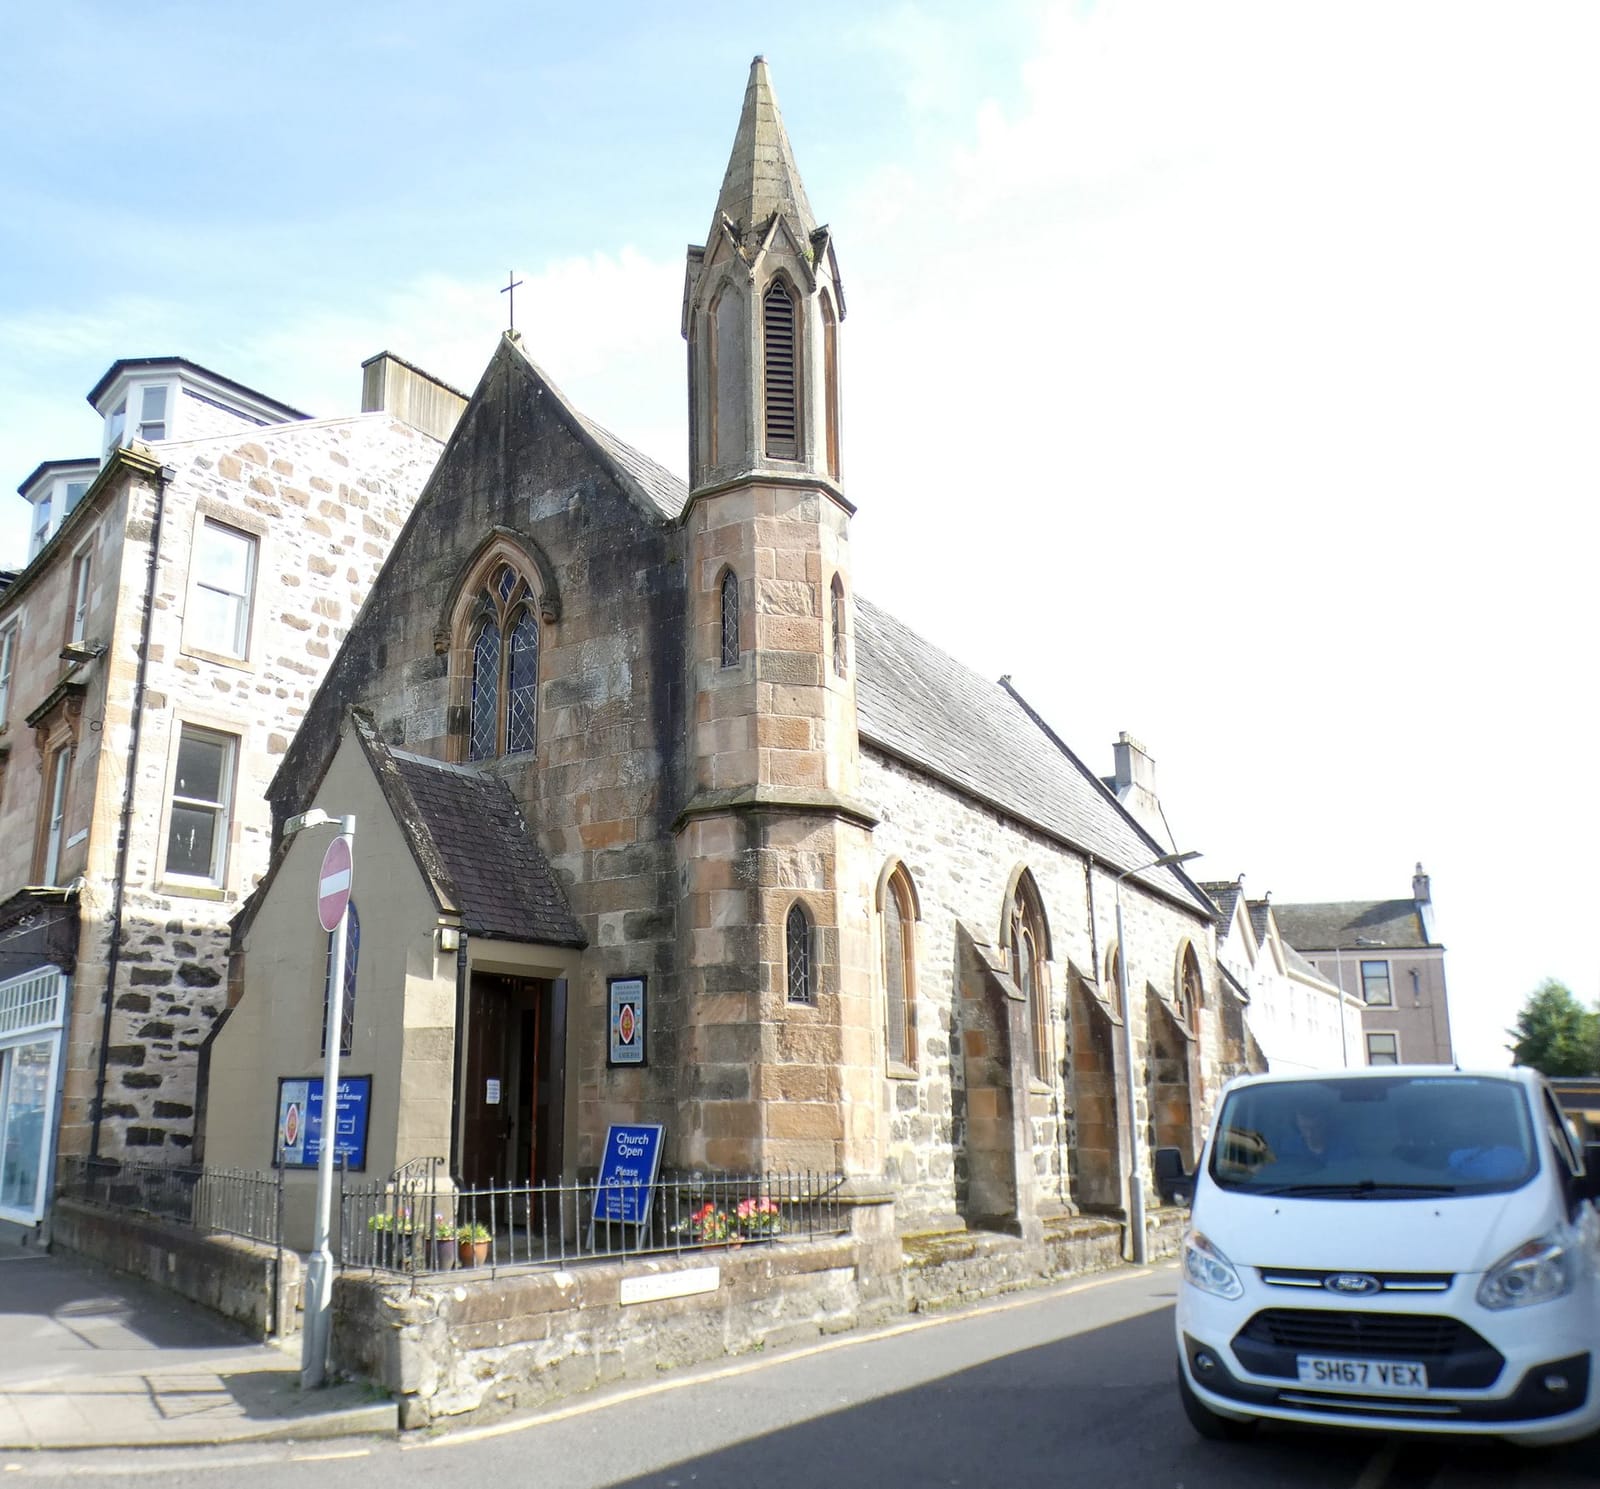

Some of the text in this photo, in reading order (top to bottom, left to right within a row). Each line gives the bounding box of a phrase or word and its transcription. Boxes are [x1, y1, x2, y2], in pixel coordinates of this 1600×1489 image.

[616, 1132, 648, 1144] Church
[618, 1145, 643, 1158] Open
[615, 1166, 639, 1177] Please
[1337, 1277, 1367, 1291] Ford
[1312, 1361, 1422, 1387] SH67 VEX
